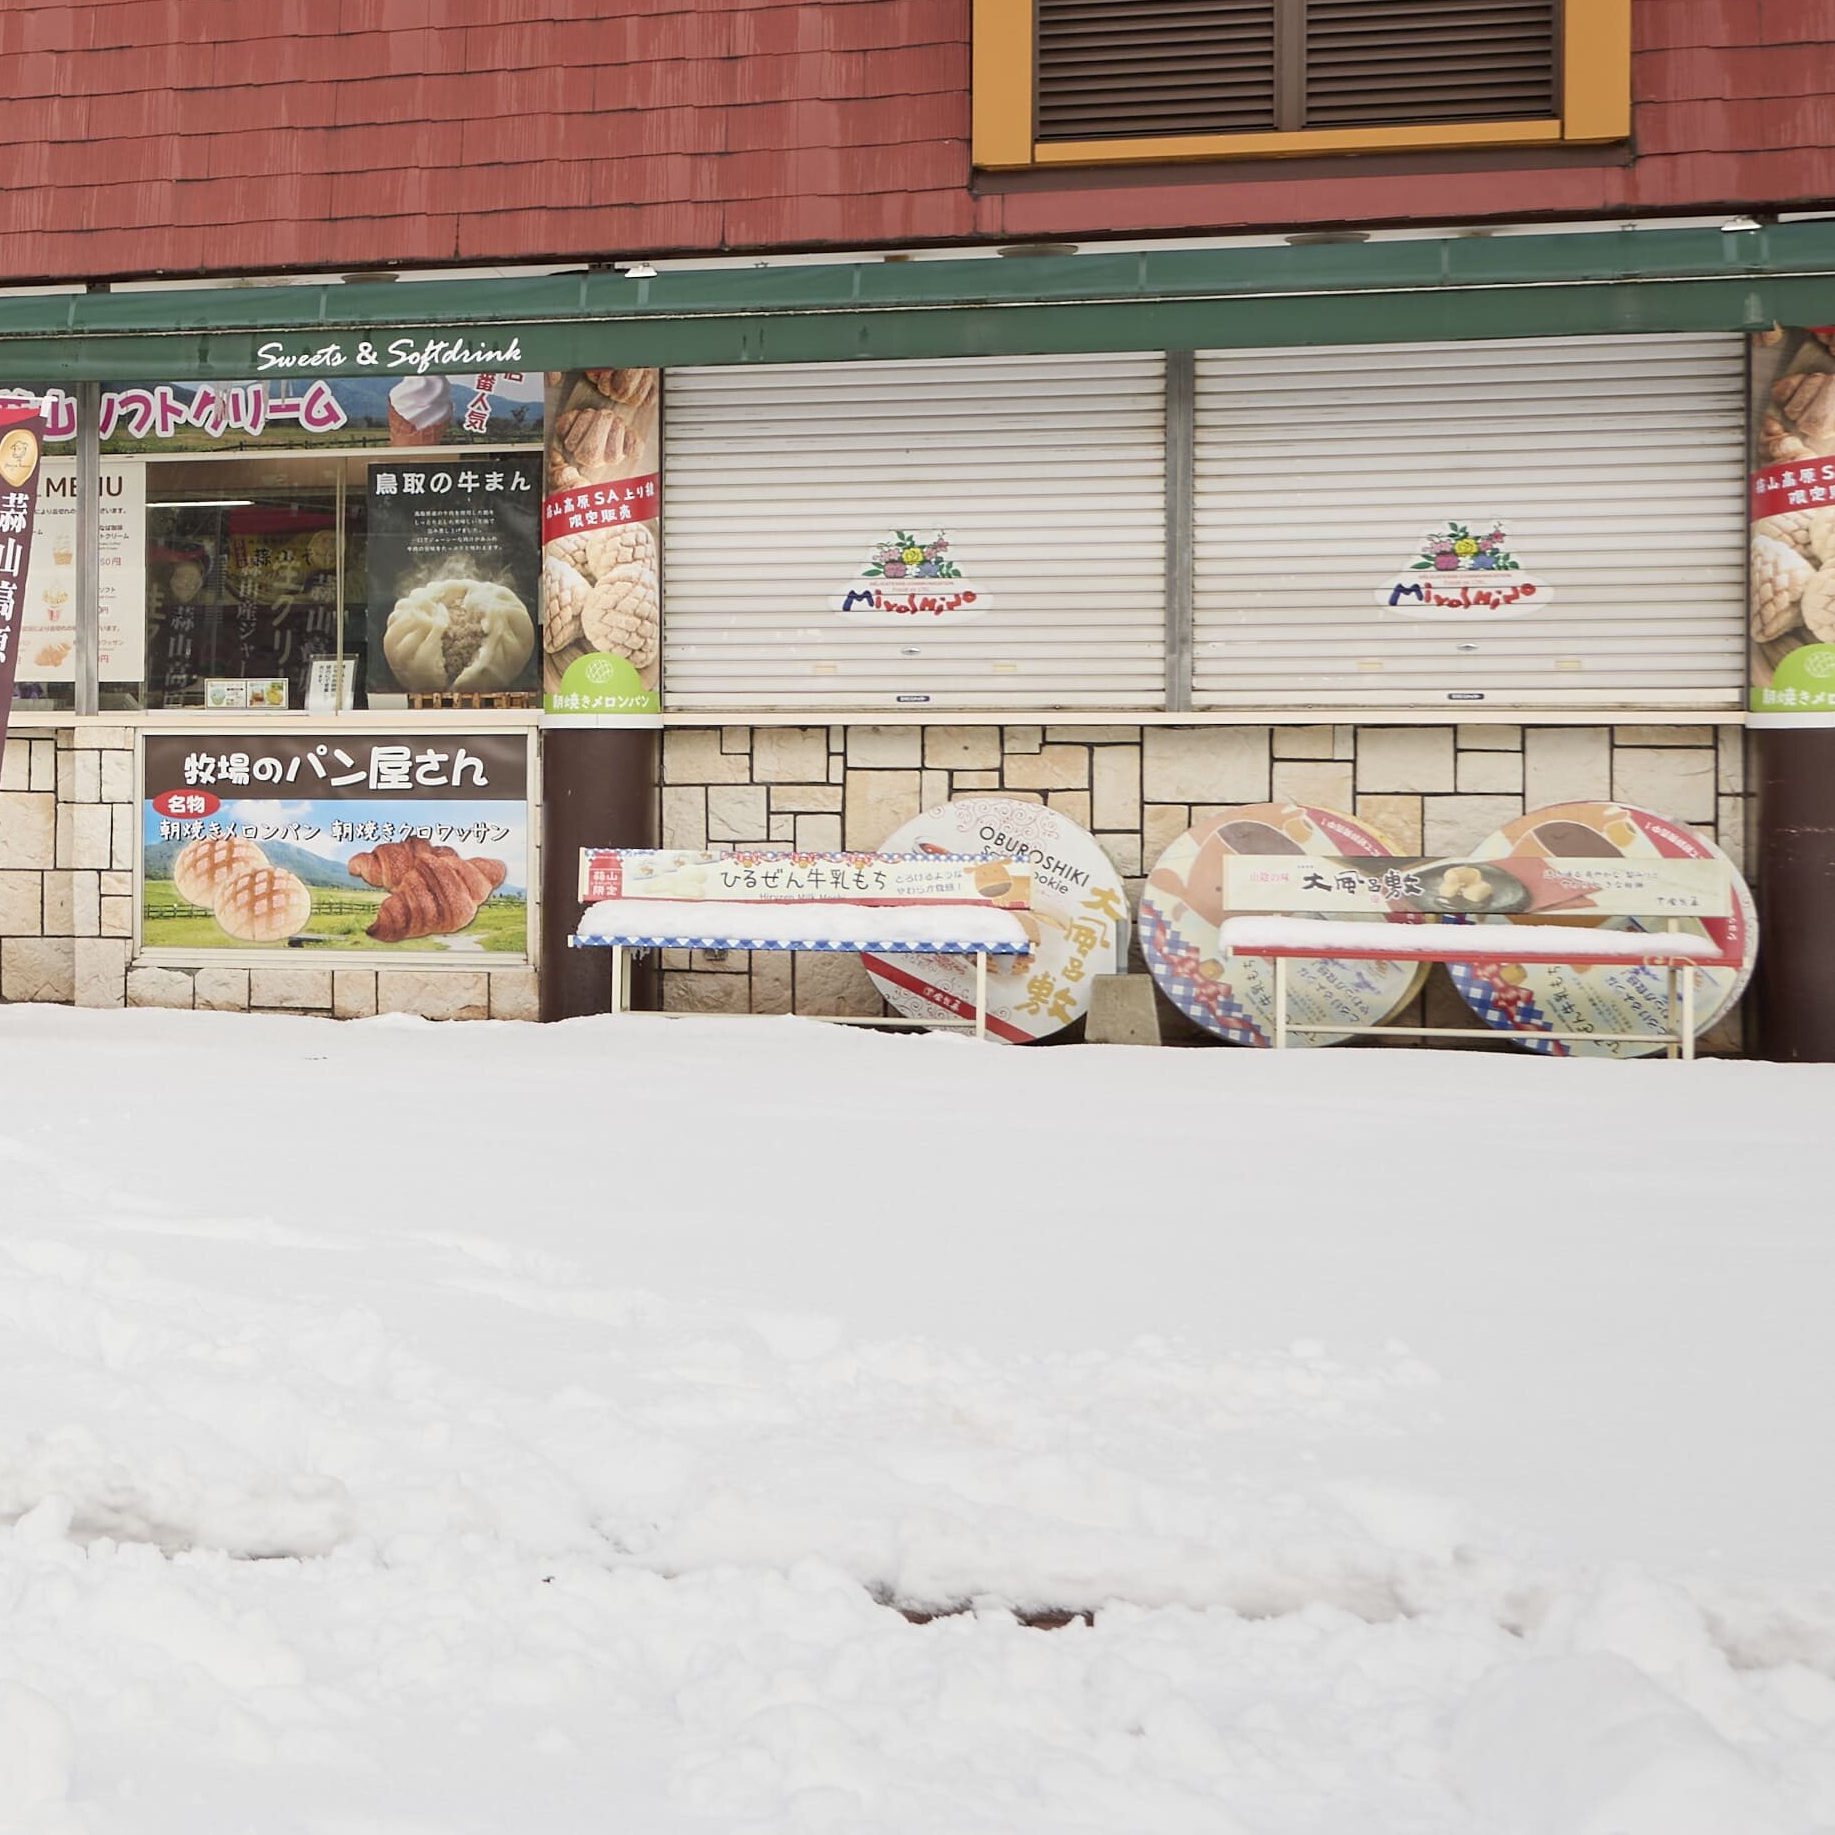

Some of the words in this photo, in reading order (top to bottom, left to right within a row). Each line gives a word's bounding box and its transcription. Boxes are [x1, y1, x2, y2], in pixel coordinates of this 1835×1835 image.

[257, 342, 348, 372] Sweets
[356, 343, 379, 365] &
[386, 338, 523, 374] Softdrink
[375, 470, 532, 495] 鳥取の牛まん
[568, 504, 633, 528] 限定販売
[184, 744, 489, 791] 牧場のパン屋さん
[167, 794, 206, 814] 名物
[159, 820, 321, 843] 朝焼きメロンパン
[331, 819, 510, 843] 朝焼きクロワッサン
[720, 868, 888, 891] ひるぜん牛乳もち
[1301, 869, 1425, 900] 大風呂敷
